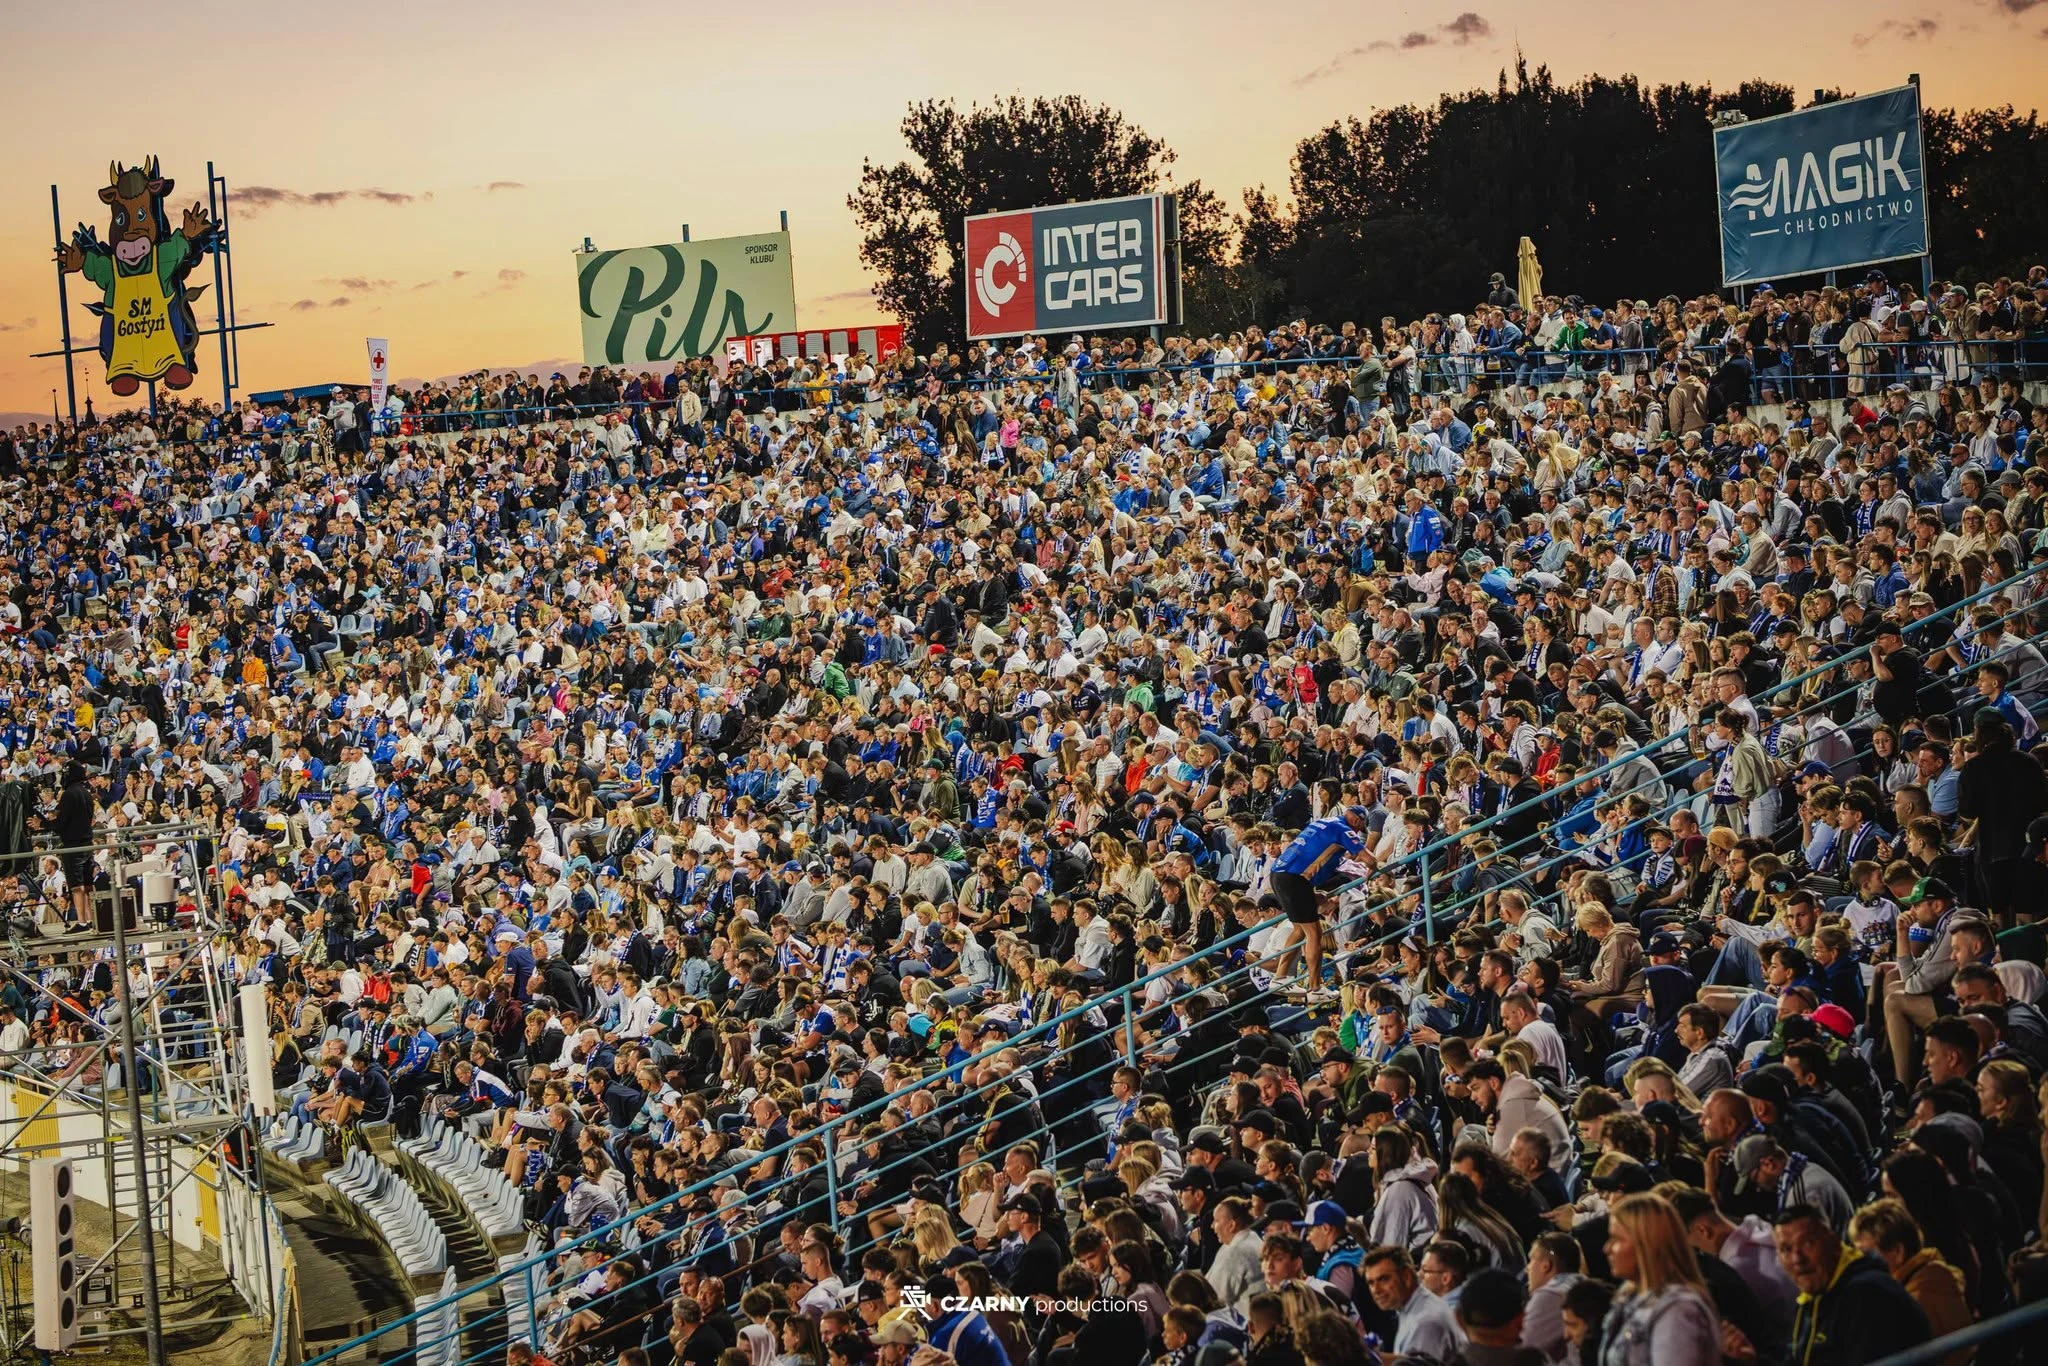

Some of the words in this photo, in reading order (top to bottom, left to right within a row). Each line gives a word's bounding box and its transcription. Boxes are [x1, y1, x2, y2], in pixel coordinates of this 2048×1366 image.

[1728, 131, 1912, 221] MAGIK
[1784, 199, 1913, 236] CHŁODNICTWO
[744, 243, 778, 255] SPONSOR
[750, 253, 775, 265] KLUBU
[1043, 218, 1143, 266] INTER
[578, 244, 774, 365] Pils
[1045, 263, 1144, 310] CARS
[117, 312, 165, 339] Gostyń
[128, 297, 152, 318] SM
